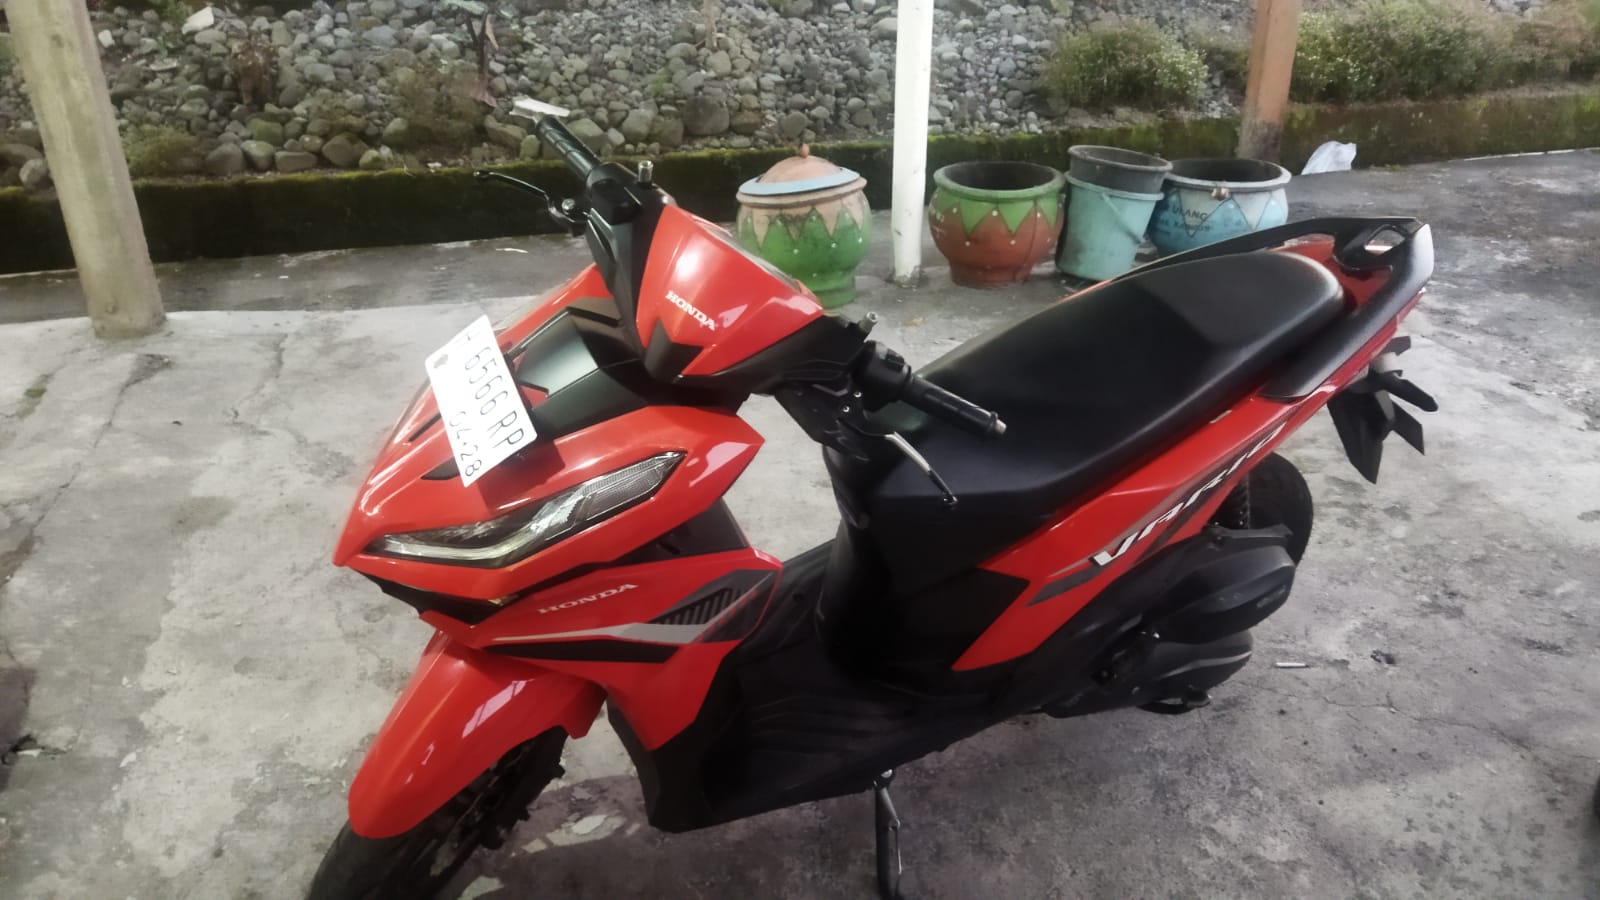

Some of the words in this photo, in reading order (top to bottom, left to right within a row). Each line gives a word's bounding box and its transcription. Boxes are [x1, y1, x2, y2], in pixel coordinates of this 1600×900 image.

[665, 290, 715, 331] HONDA
[464, 346, 509, 416] 6566
[486, 410, 524, 449] RP
[1093, 421, 1287, 566] VARIO
[537, 584, 639, 614] HONDA
